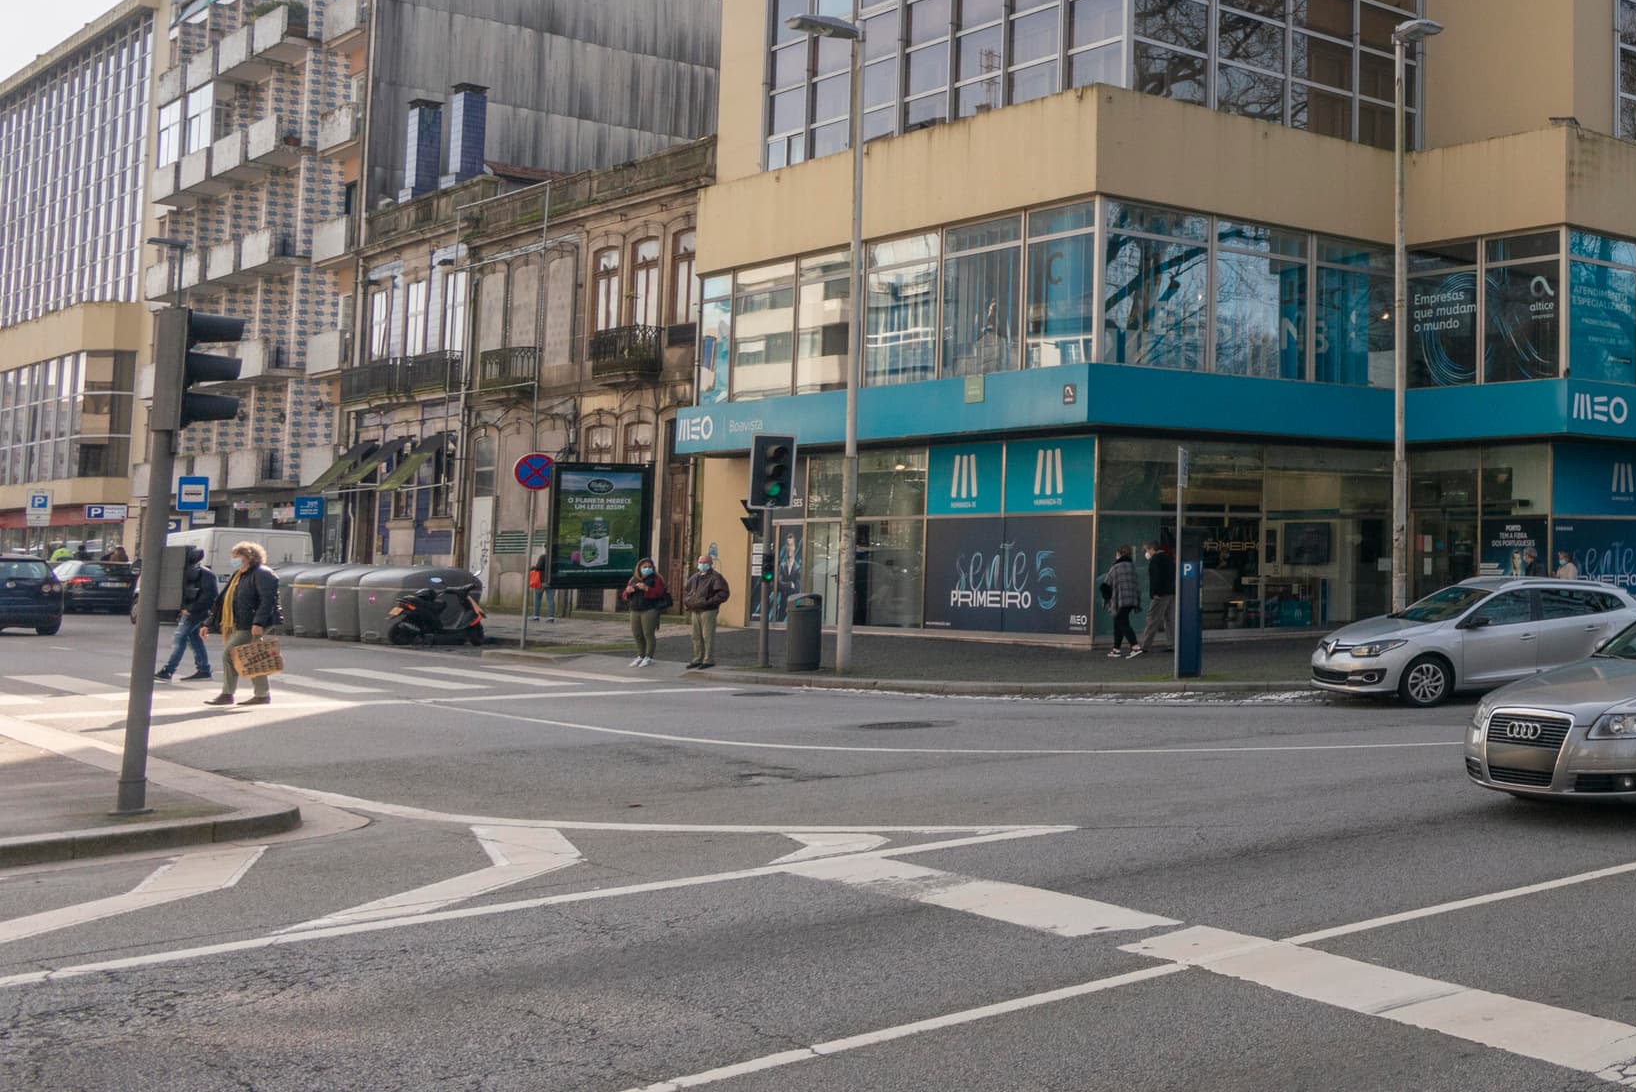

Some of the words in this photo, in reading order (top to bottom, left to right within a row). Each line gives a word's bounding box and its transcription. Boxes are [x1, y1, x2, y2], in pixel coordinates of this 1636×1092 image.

[1414, 291, 1465, 306] Empresas
[1413, 310, 1433, 321] que
[1436, 304, 1477, 317] mudam
[1529, 301, 1554, 312] altice
[1413, 324, 1421, 332] o
[1423, 318, 1460, 332] mundo
[1573, 392, 1628, 424] MEO
[678, 415, 713, 440] MEO
[729, 419, 763, 433] Boavista
[950, 590, 1031, 609] PRIMEIRO
[1069, 614, 1087, 626] MEO
